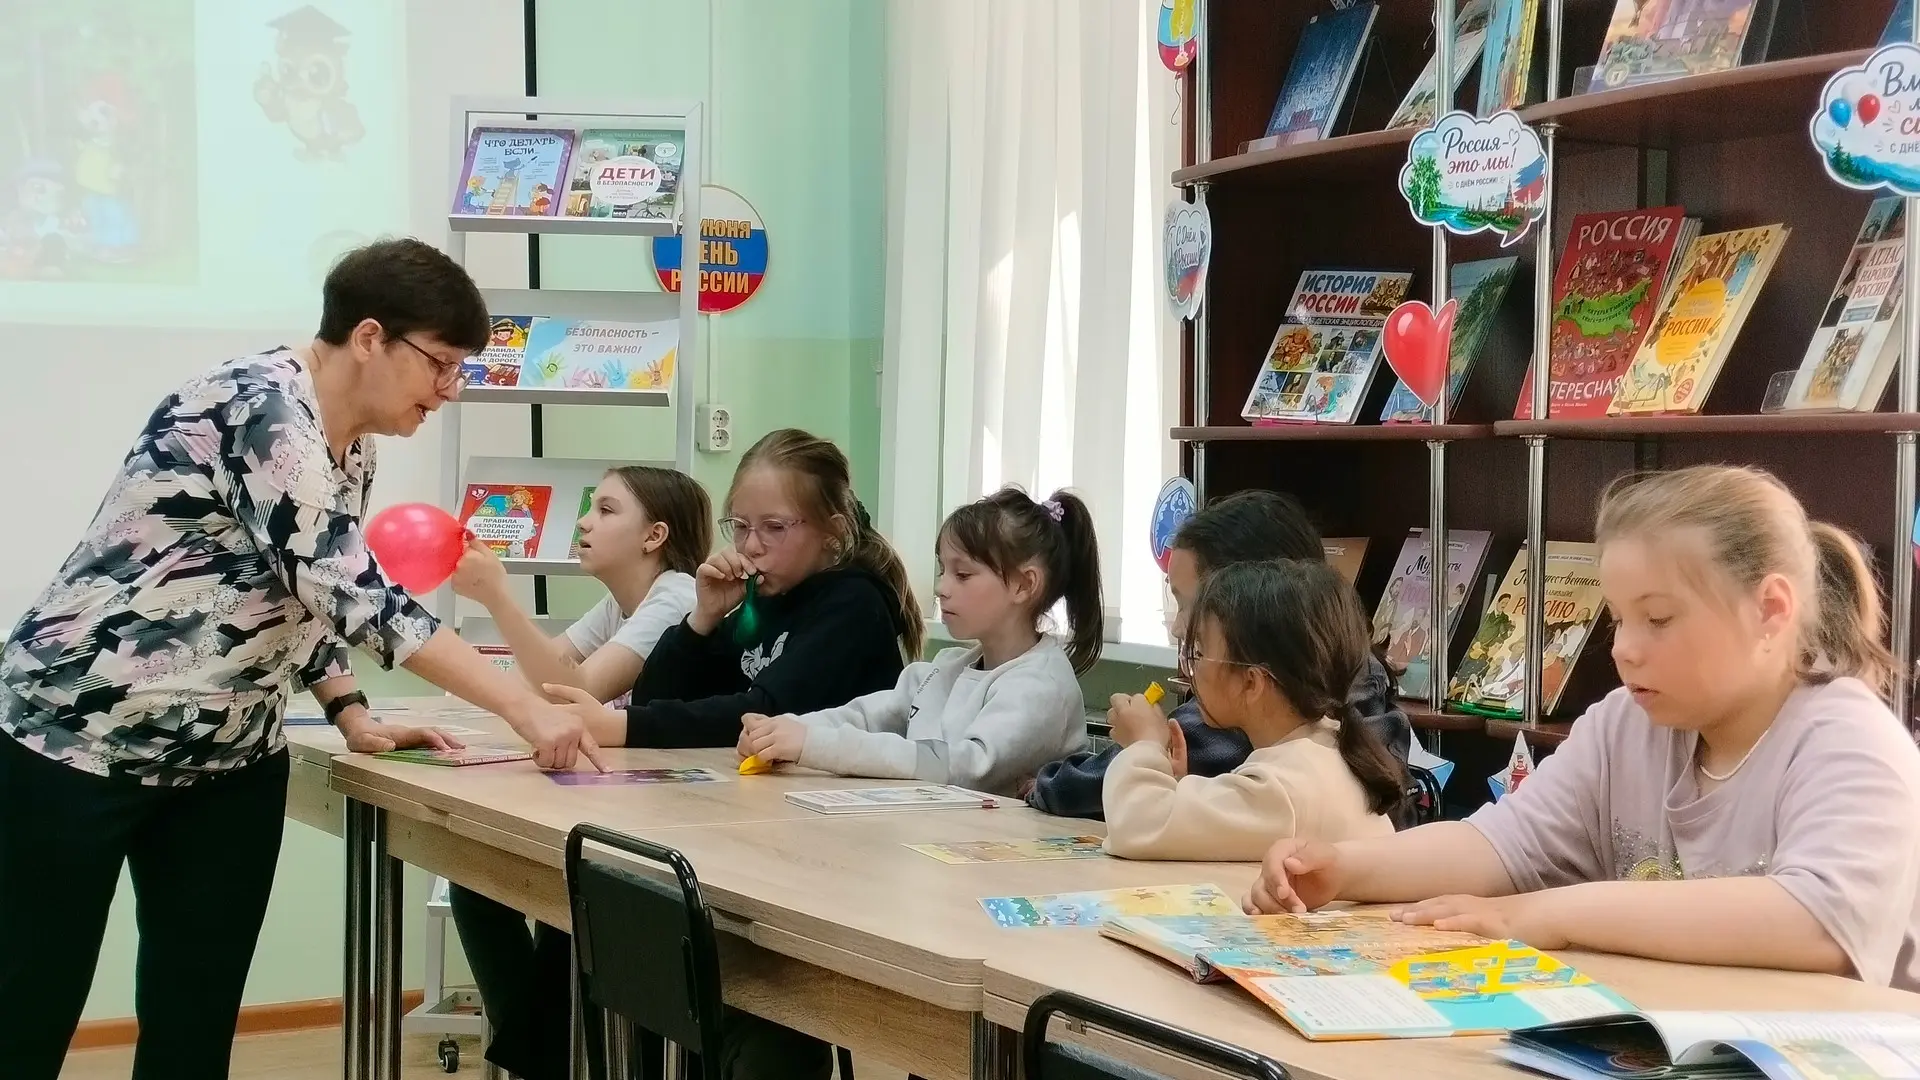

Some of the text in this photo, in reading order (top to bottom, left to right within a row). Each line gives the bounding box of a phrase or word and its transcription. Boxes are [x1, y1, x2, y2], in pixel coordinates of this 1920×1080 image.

[484, 139, 507, 148] ЧТО
[1447, 147, 1516, 174] это мы!
[598, 167, 655, 181] ДЕТИ
[1578, 215, 1673, 250] РОССИЯ
[699, 240, 739, 266] ЕНЬ
[670, 268, 749, 294] РССИИ
[1302, 273, 1377, 295] ИСТОРИЯ
[1852, 281, 1890, 300] РОССИИ
[1293, 293, 1361, 314] РОССИИ
[565, 327, 648, 339] БЕЗОПАСНОСТЬ
[1662, 317, 1712, 338] РОССИИ
[573, 344, 642, 354] ЭТО ВАЖНО!
[1550, 375, 1624, 401] ТЕРЕСНАЯ
